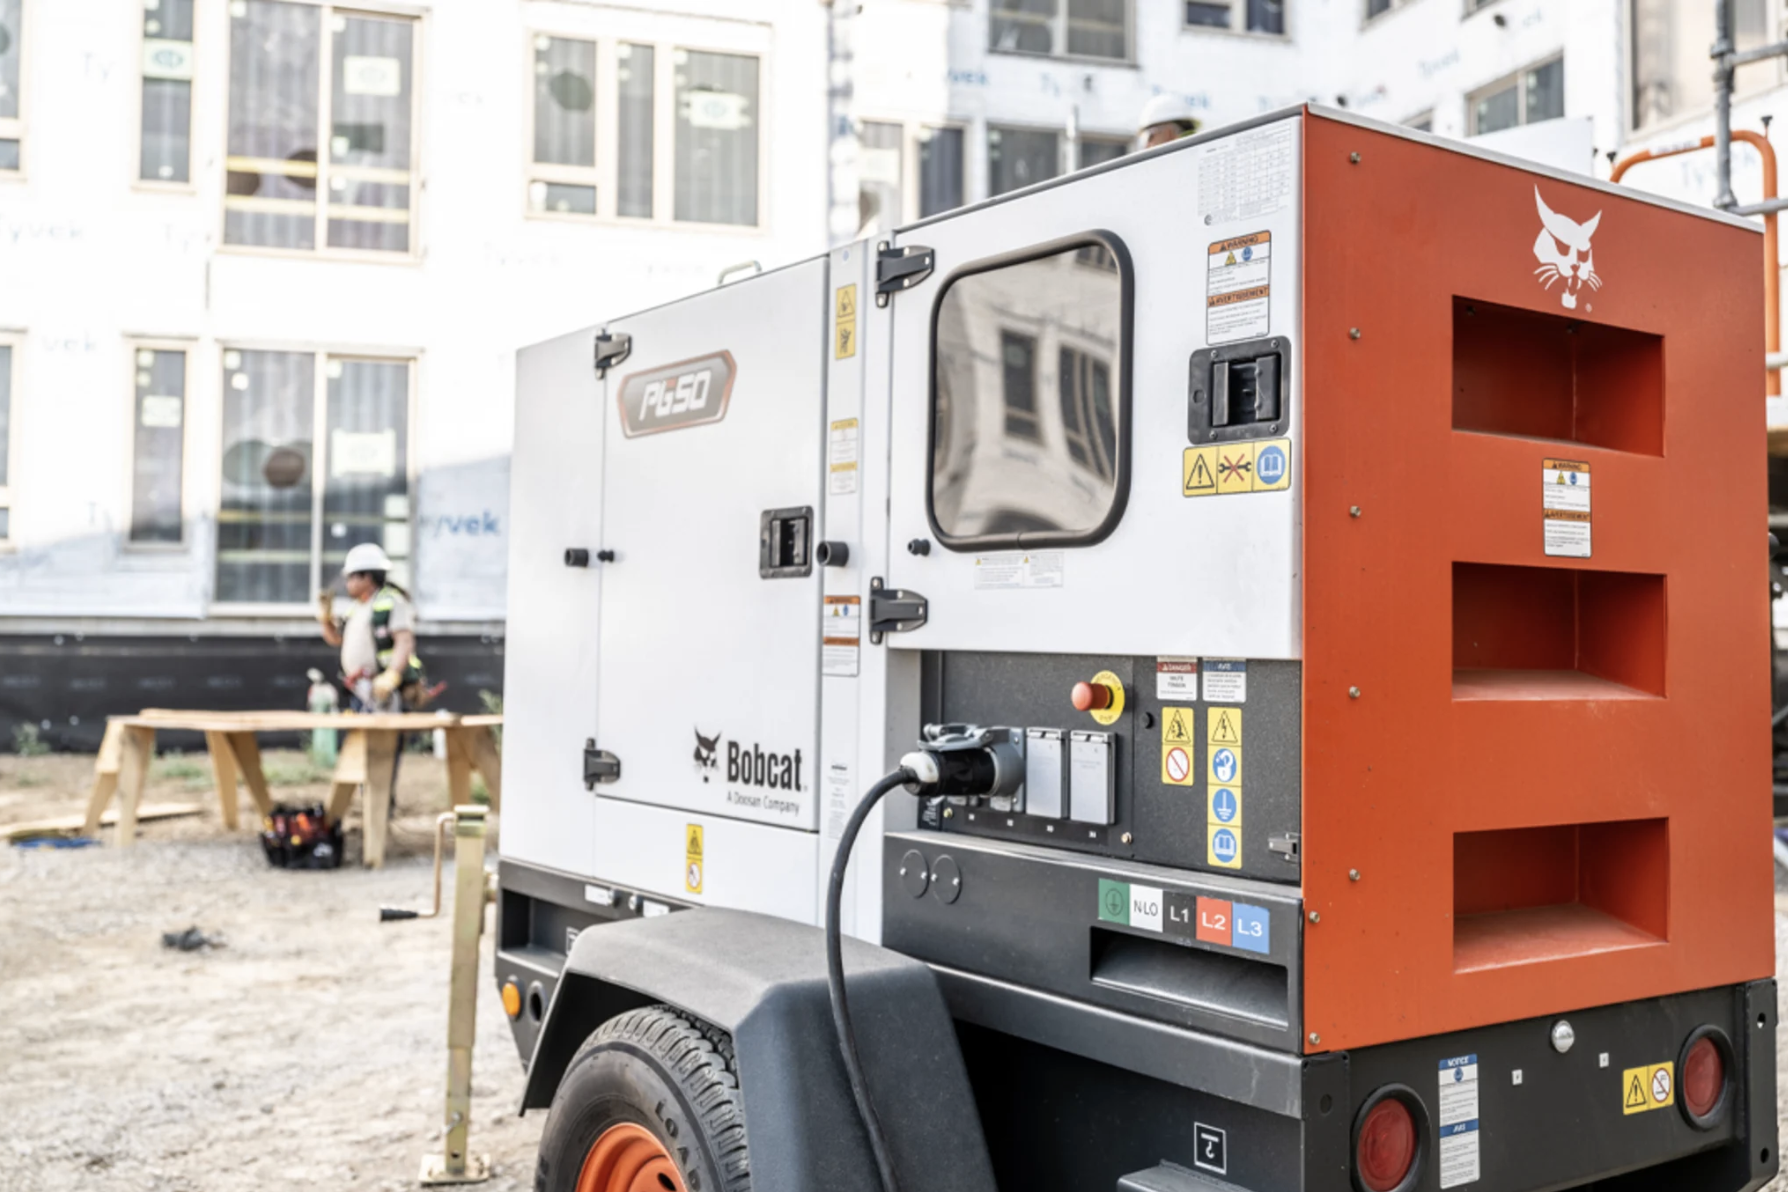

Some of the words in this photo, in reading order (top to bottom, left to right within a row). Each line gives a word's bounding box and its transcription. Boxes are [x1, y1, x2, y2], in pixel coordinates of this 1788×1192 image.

[727, 740, 802, 792] Bobcat
[727, 790, 733, 803] A
[734, 791, 761, 808] Doosan
[763, 795, 800, 817] Company
[1170, 905, 1190, 924] L1
[1202, 911, 1226, 931] L2
[1237, 918, 1263, 938] L3
